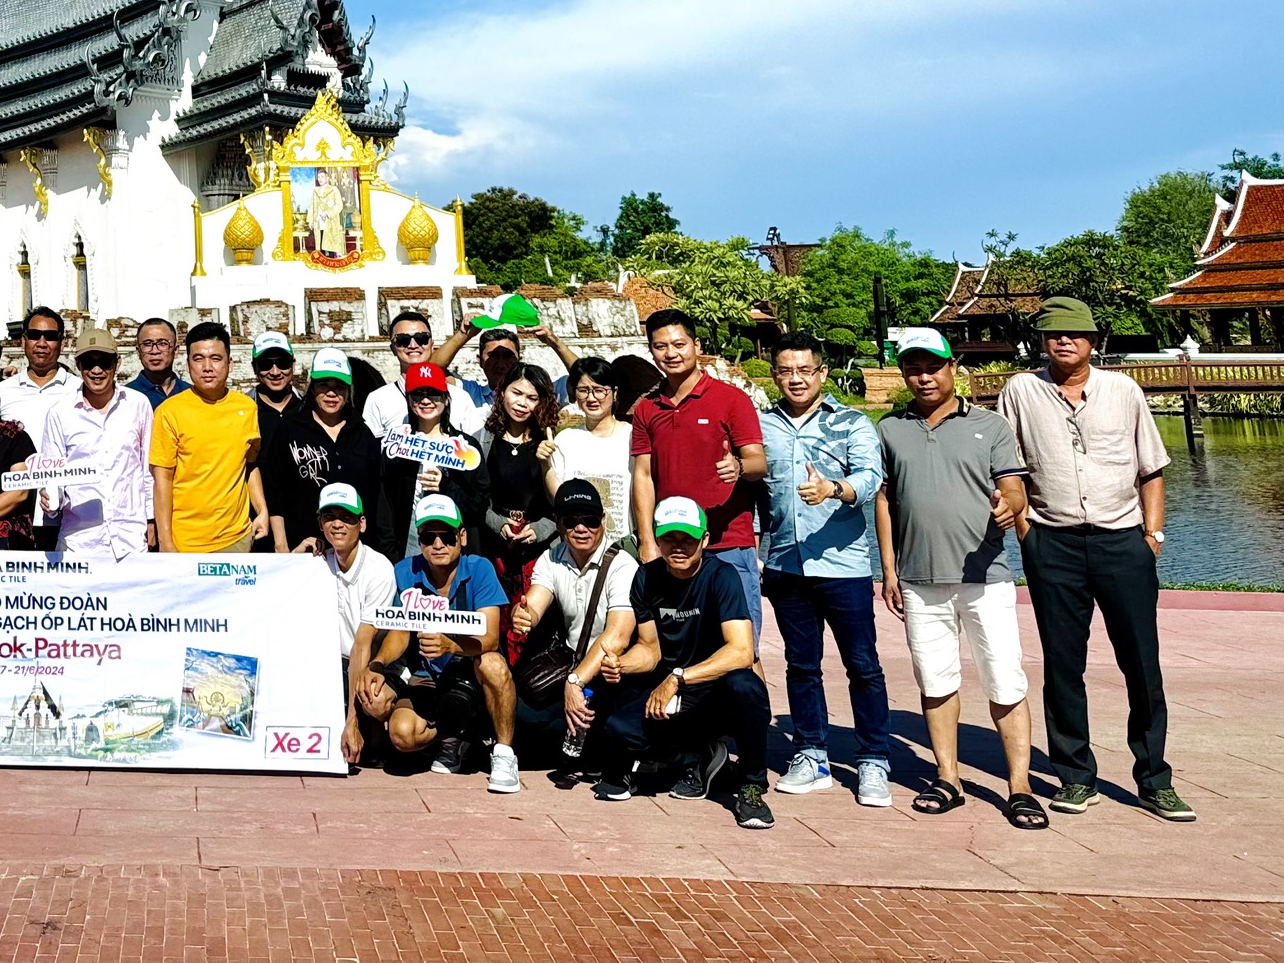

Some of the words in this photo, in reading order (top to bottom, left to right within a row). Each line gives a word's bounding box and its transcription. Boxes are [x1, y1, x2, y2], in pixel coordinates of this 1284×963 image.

[404, 434, 428, 448] HẾT
[4, 473, 30, 482] HOA
[32, 470, 62, 480] BINH
[64, 467, 97, 477] MINH
[6, 561, 45, 574] BINH
[47, 562, 90, 574] MINH
[199, 563, 257, 575] BETANAM
[9, 575, 27, 583] TILE
[235, 577, 257, 586] travel
[5, 591, 56, 610] MỪNG
[59, 592, 107, 611] ĐOÀN
[41, 612, 64, 631] ỐP
[67, 612, 97, 632] LÁT
[100, 613, 137, 632] HOÀ
[140, 614, 180, 633] BÌNH
[184, 618, 228, 633] MINH
[376, 609, 405, 620] HOA
[408, 611, 442, 622] BINH
[444, 613, 481, 625] MINH
[269, 732, 301, 754] Xe
[306, 732, 322, 754] 2
